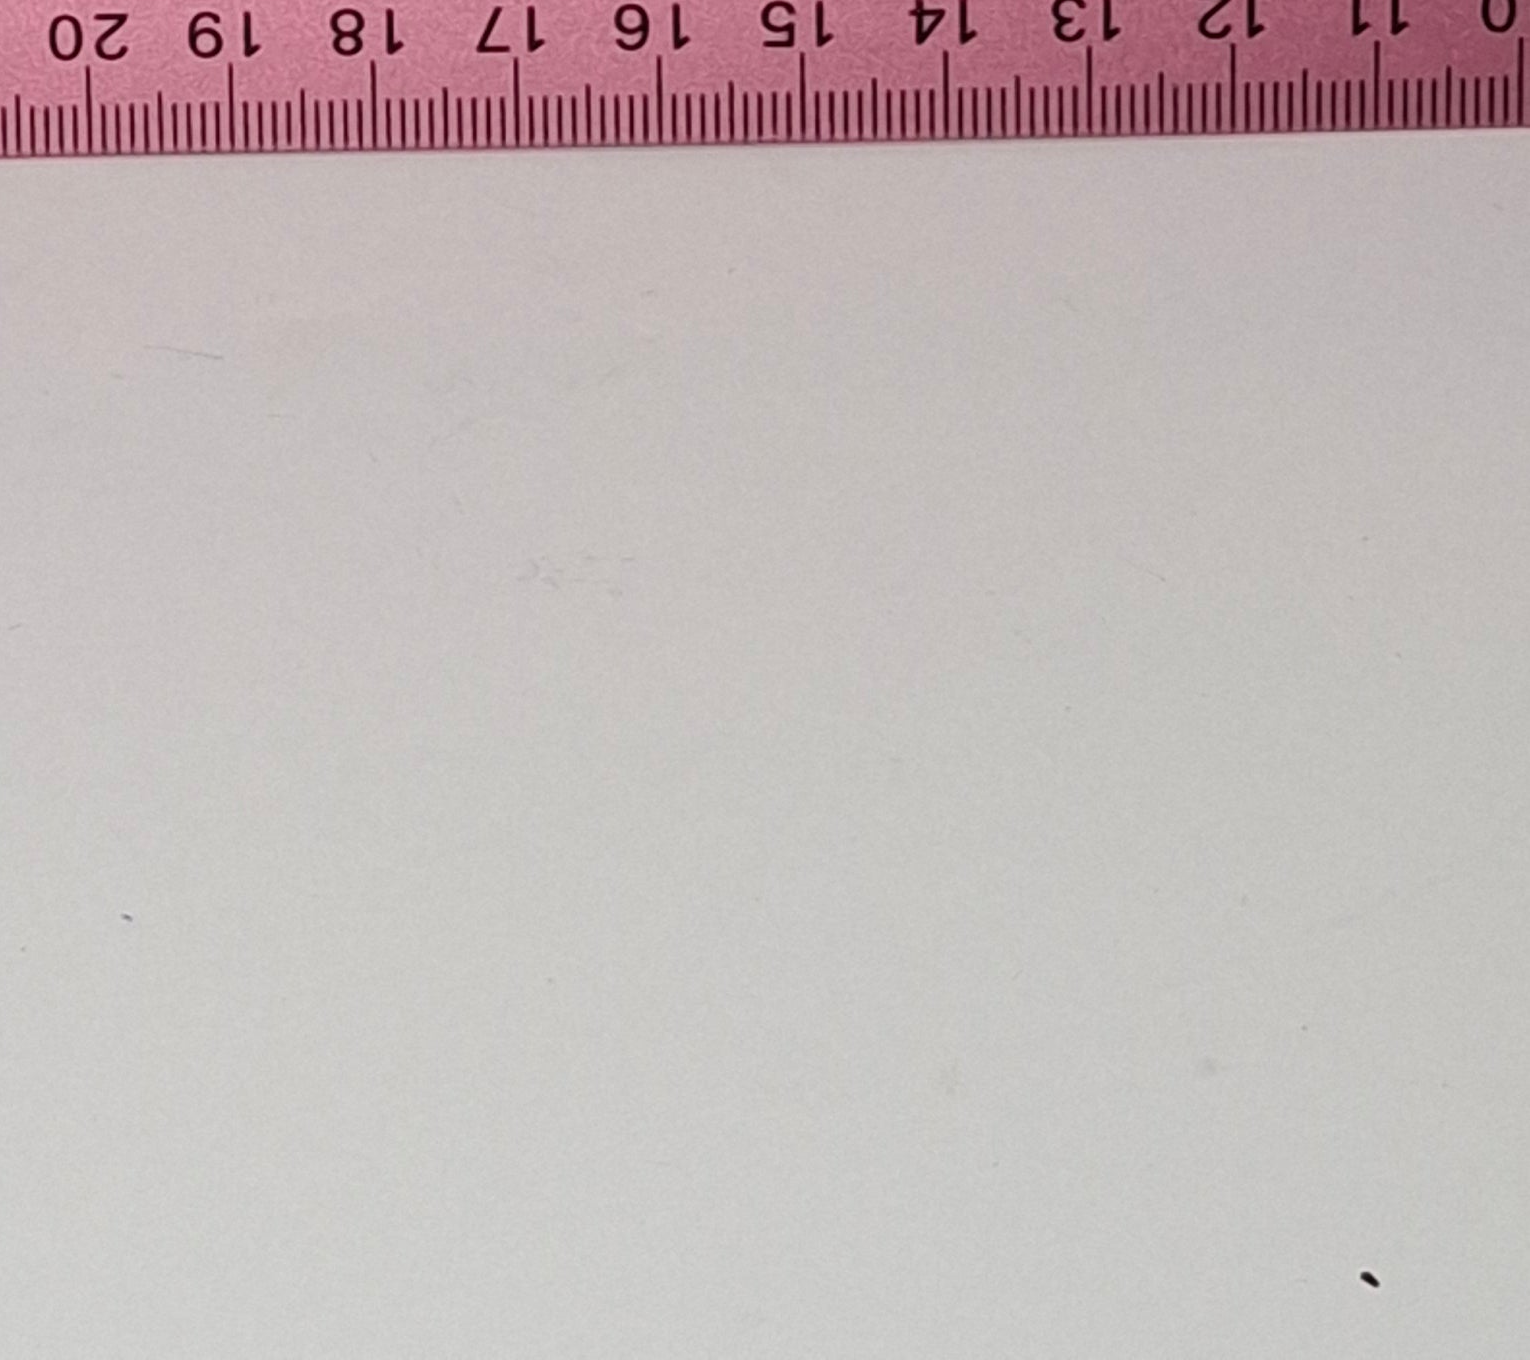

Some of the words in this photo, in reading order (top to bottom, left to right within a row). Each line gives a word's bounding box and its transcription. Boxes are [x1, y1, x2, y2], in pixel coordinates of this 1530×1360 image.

[48, 13, 129, 62] 20
[187, 11, 261, 59] 19
[329, 8, 404, 57] 18
[475, 5, 545, 54] 17
[614, 3, 691, 52] 16
[760, 0, 834, 48] 15
